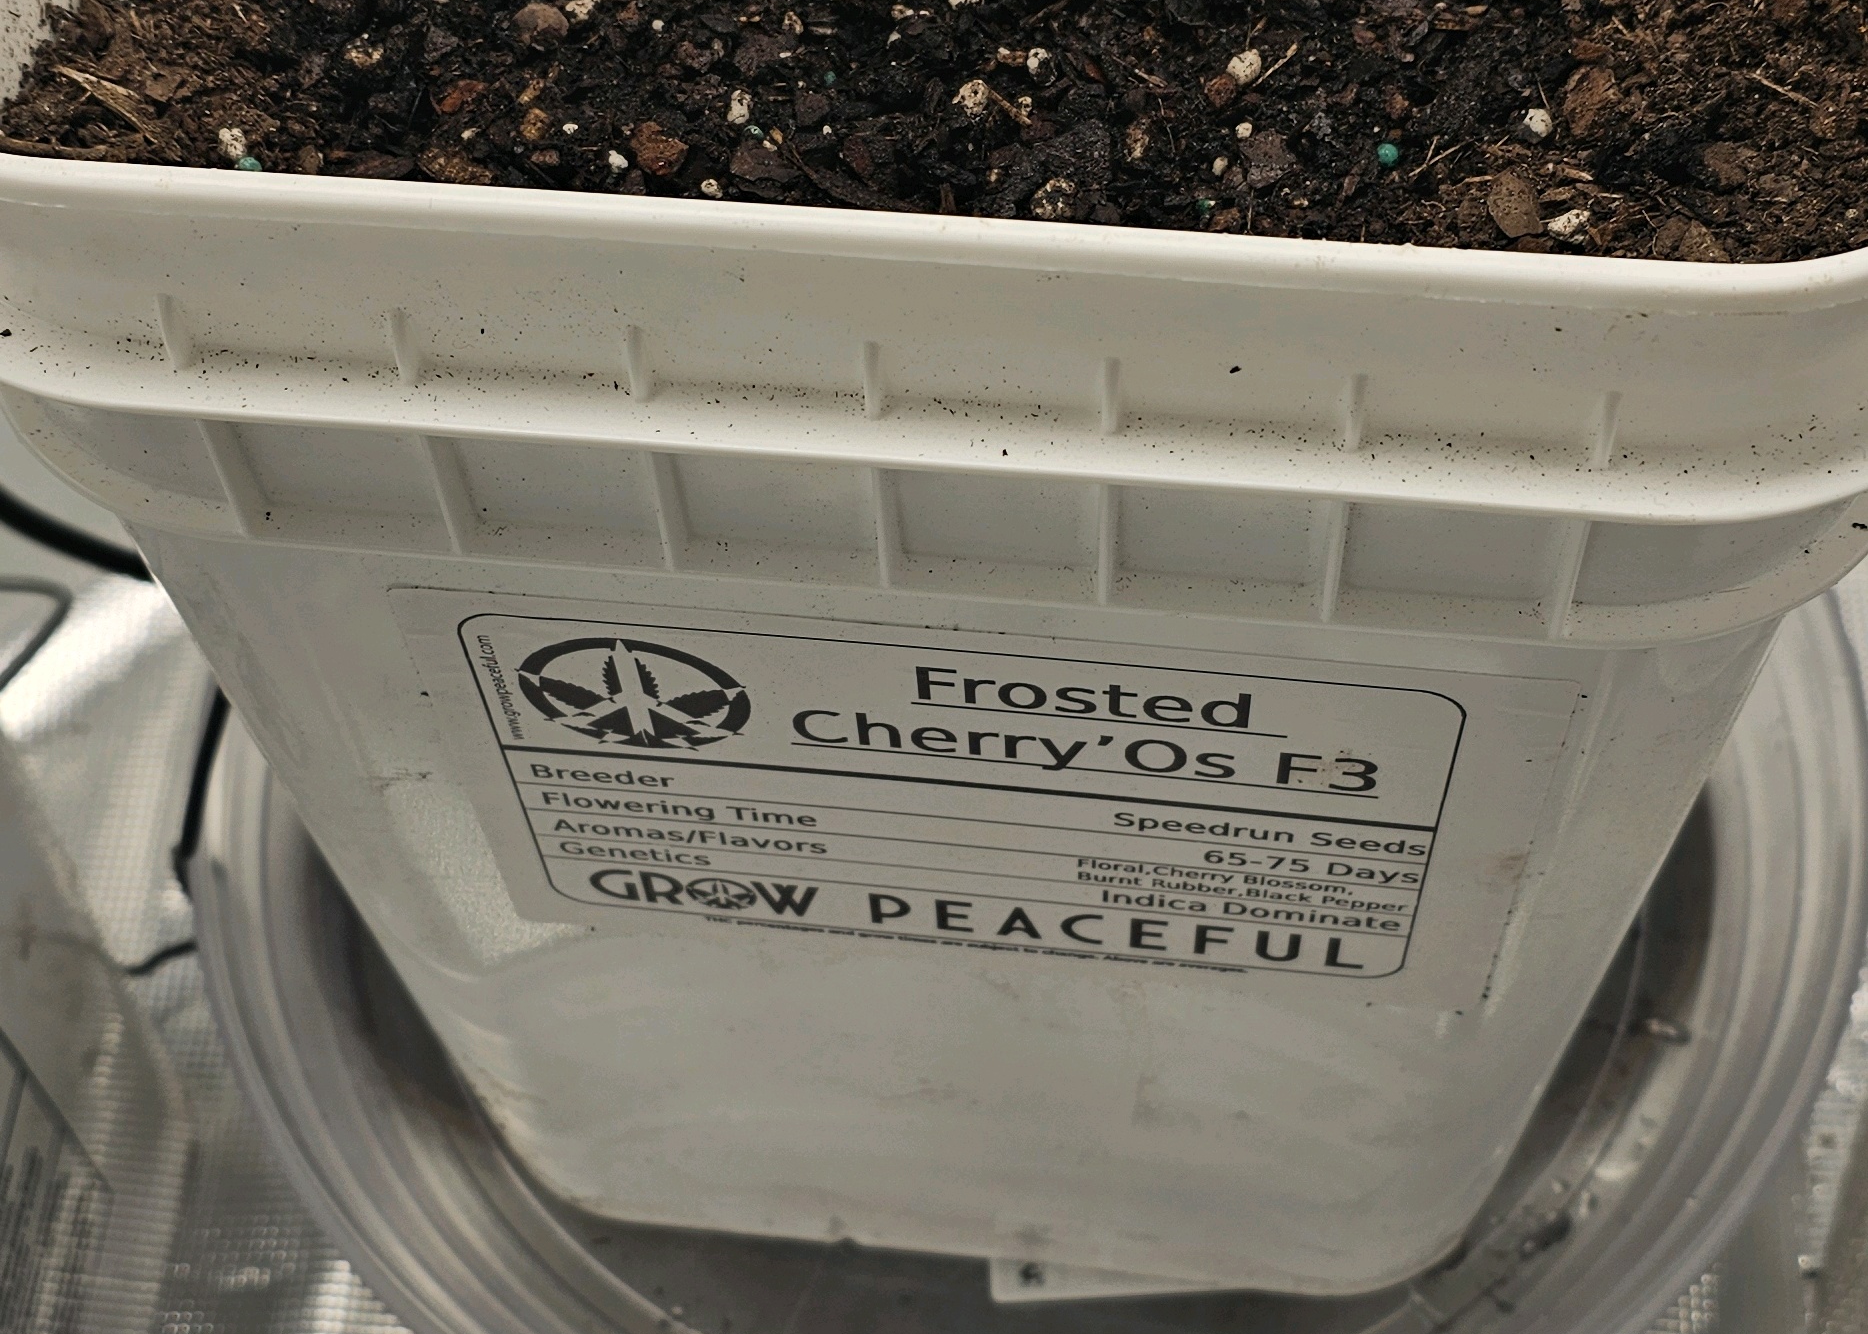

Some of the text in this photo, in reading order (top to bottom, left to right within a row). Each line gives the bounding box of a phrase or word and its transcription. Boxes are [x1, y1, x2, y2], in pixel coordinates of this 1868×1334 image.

[915, 665, 1252, 729] Frosted
[530, 763, 675, 788] Breeder
[1275, 751, 1379, 793] F3
[542, 791, 818, 828] Flowering Time
[554, 819, 828, 855] Aromas/Flavors
[559, 841, 712, 866] Genetics
[1113, 812, 1427, 857] Speedrun Seeds
[1203, 850, 1420, 884] 65-75 Days
[1243, 874, 1354, 896] Blossom,
[1077, 871, 1143, 887] Burnt
[1321, 895, 1409, 913] Pepper
[1102, 889, 1401, 932] Indica Dominate
[868, 892, 1365, 970] PEACEFUL
